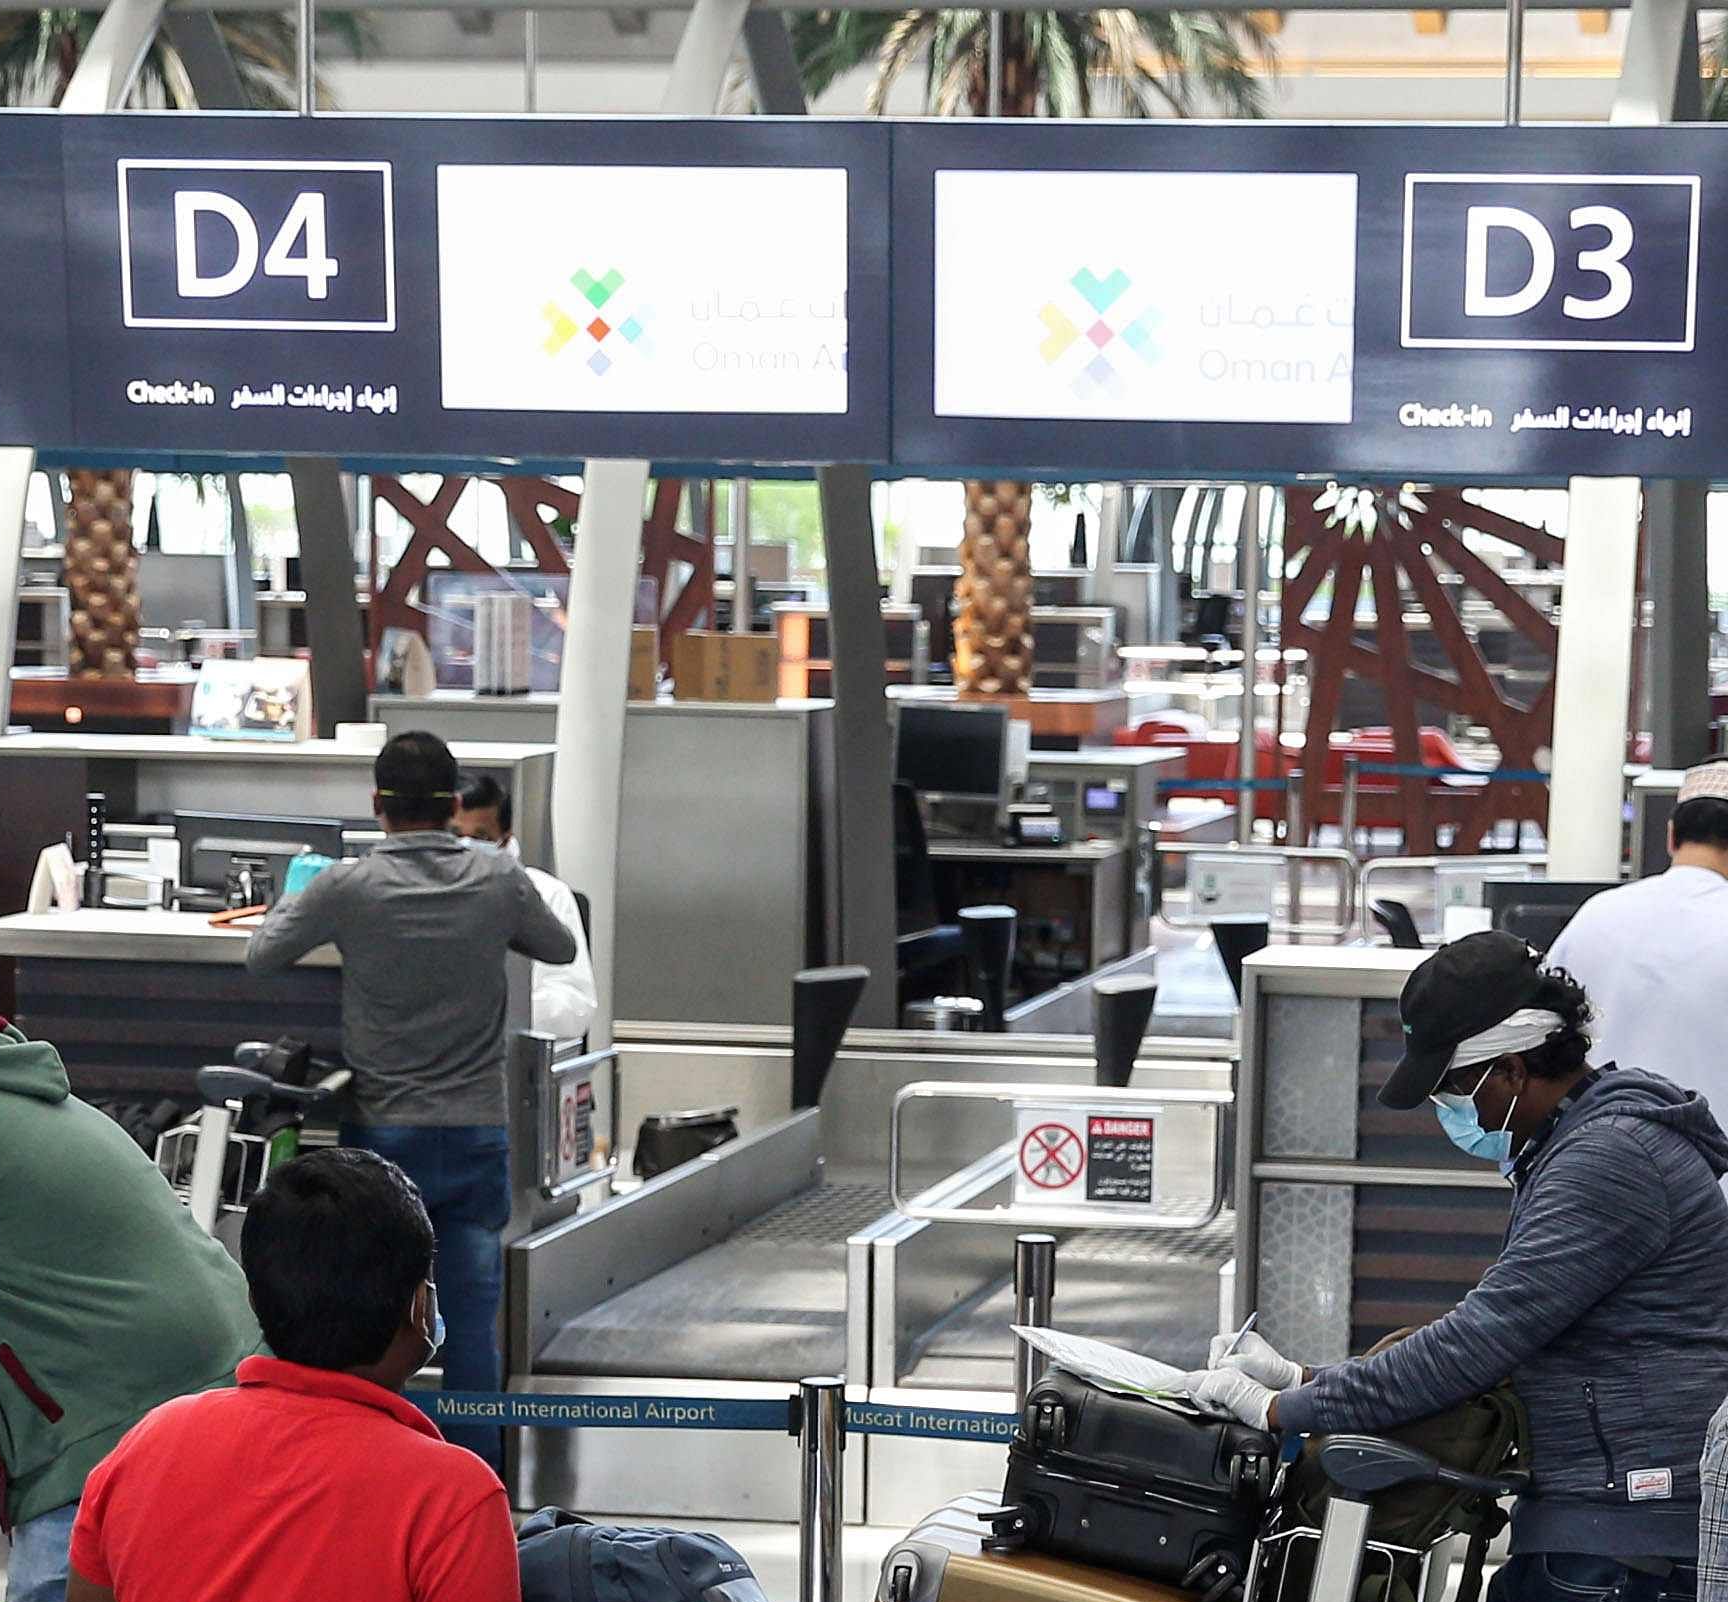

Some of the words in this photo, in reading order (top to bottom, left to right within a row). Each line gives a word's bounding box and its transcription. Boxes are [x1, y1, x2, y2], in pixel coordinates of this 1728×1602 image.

[175, 191, 338, 298] D4
[1465, 206, 1633, 319] D3
[693, 342, 800, 371] Oman
[813, 344, 837, 369] A
[1200, 349, 1314, 380] Oman
[1328, 352, 1351, 382] A
[127, 380, 214, 404] Check-in
[1400, 403, 1492, 427] Check-in
[437, 1397, 505, 1417] Muscat
[511, 1399, 639, 1421] International
[644, 1402, 716, 1425] Airport
[910, 1412, 1018, 1435] Internation
